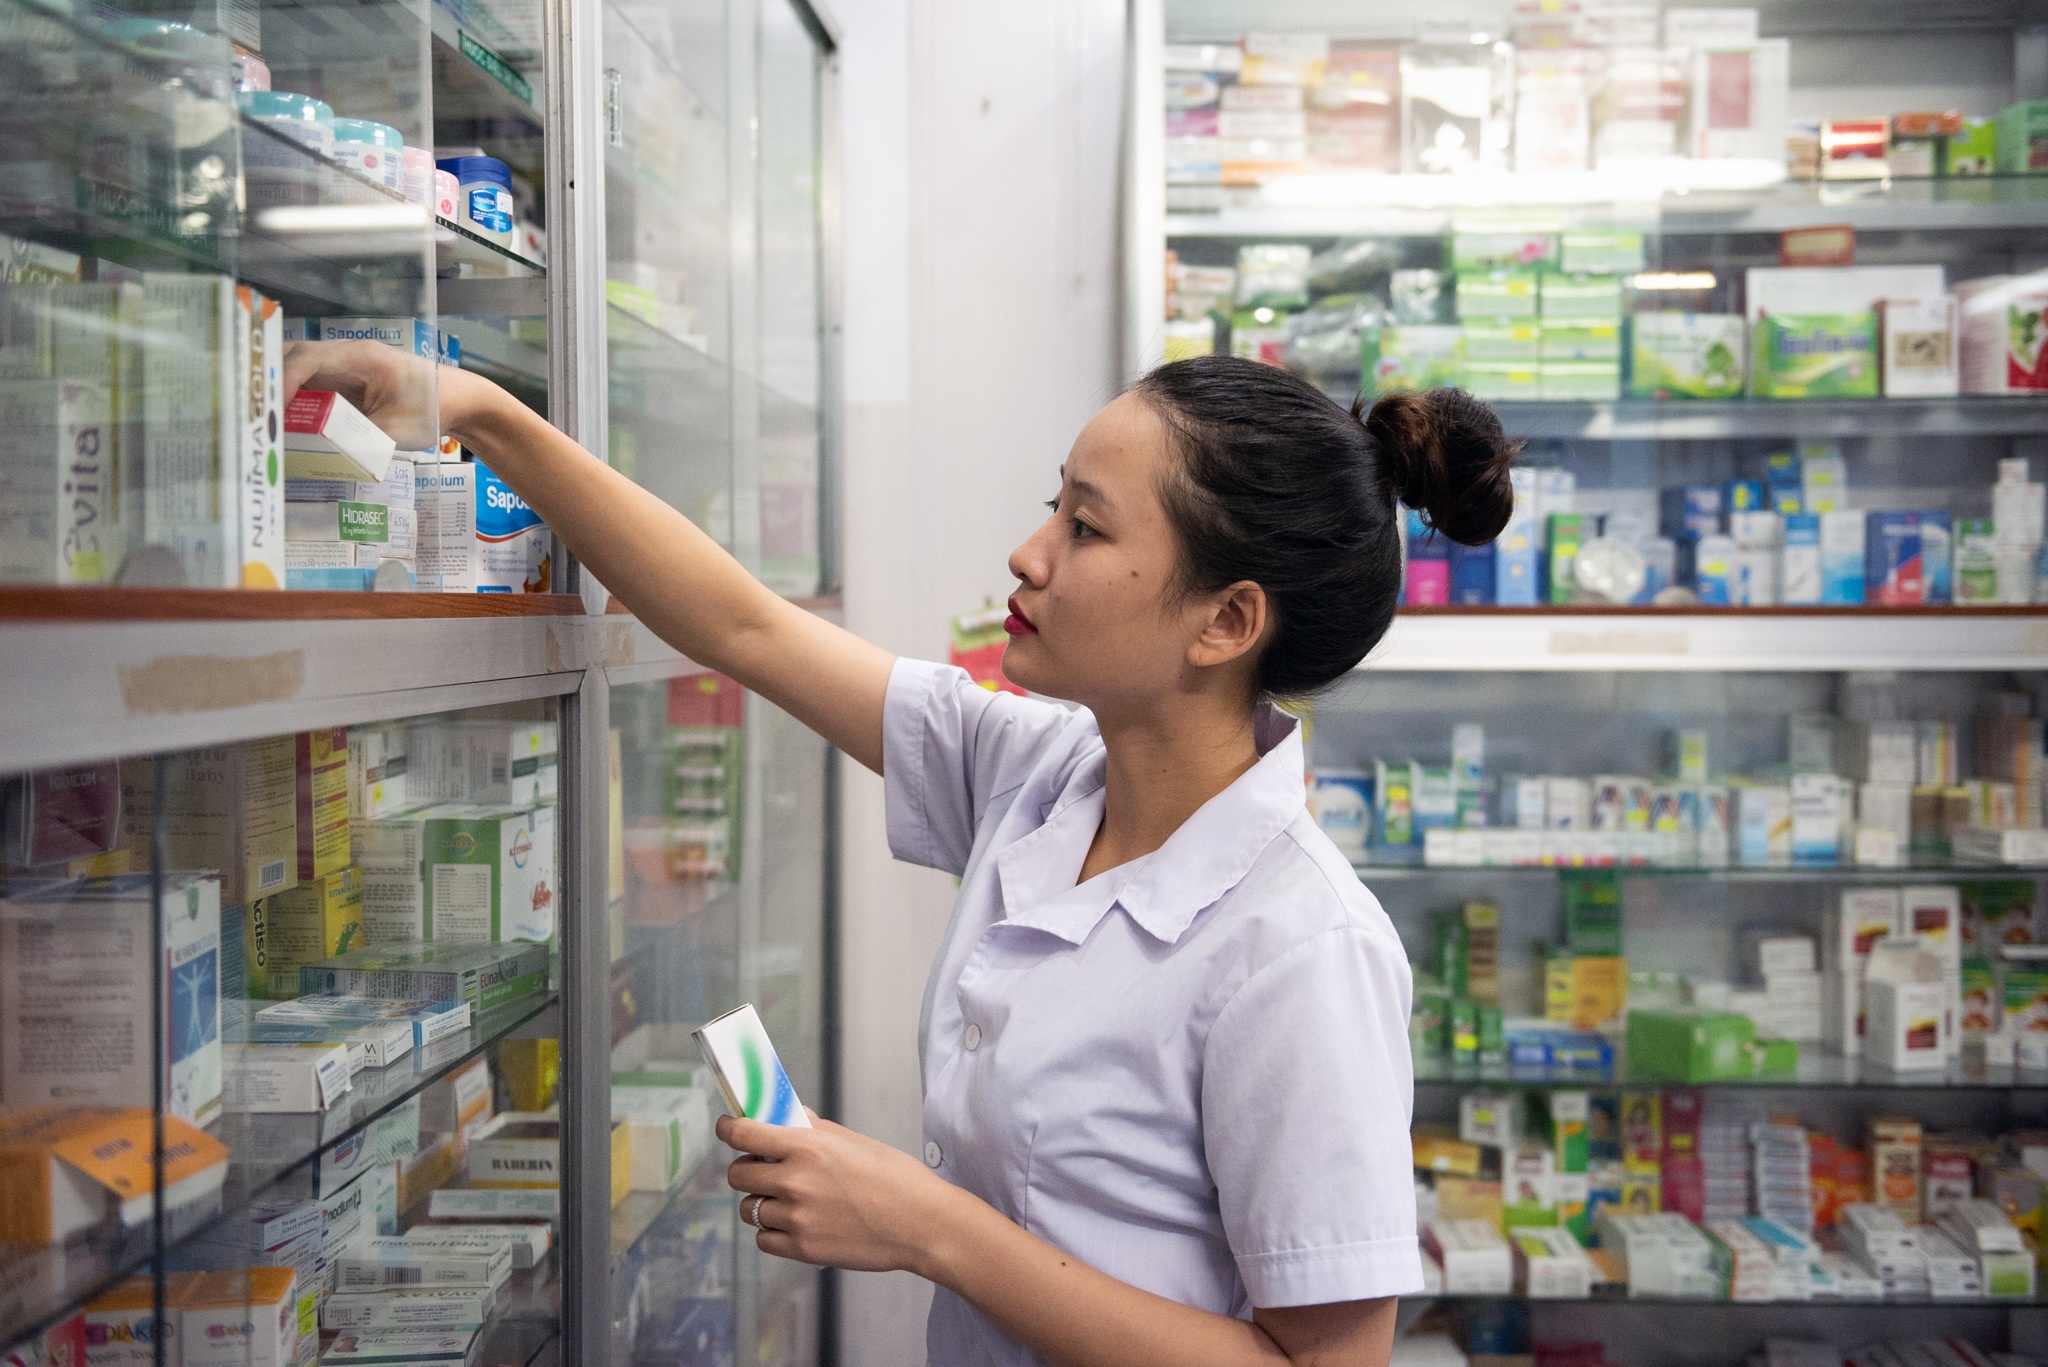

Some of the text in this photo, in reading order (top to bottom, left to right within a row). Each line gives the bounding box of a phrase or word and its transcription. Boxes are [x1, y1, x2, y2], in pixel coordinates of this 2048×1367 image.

[326, 327, 401, 340] Sapodium
[342, 508, 384, 526] HIDRASEC
[184, 766, 227, 783] Baby
